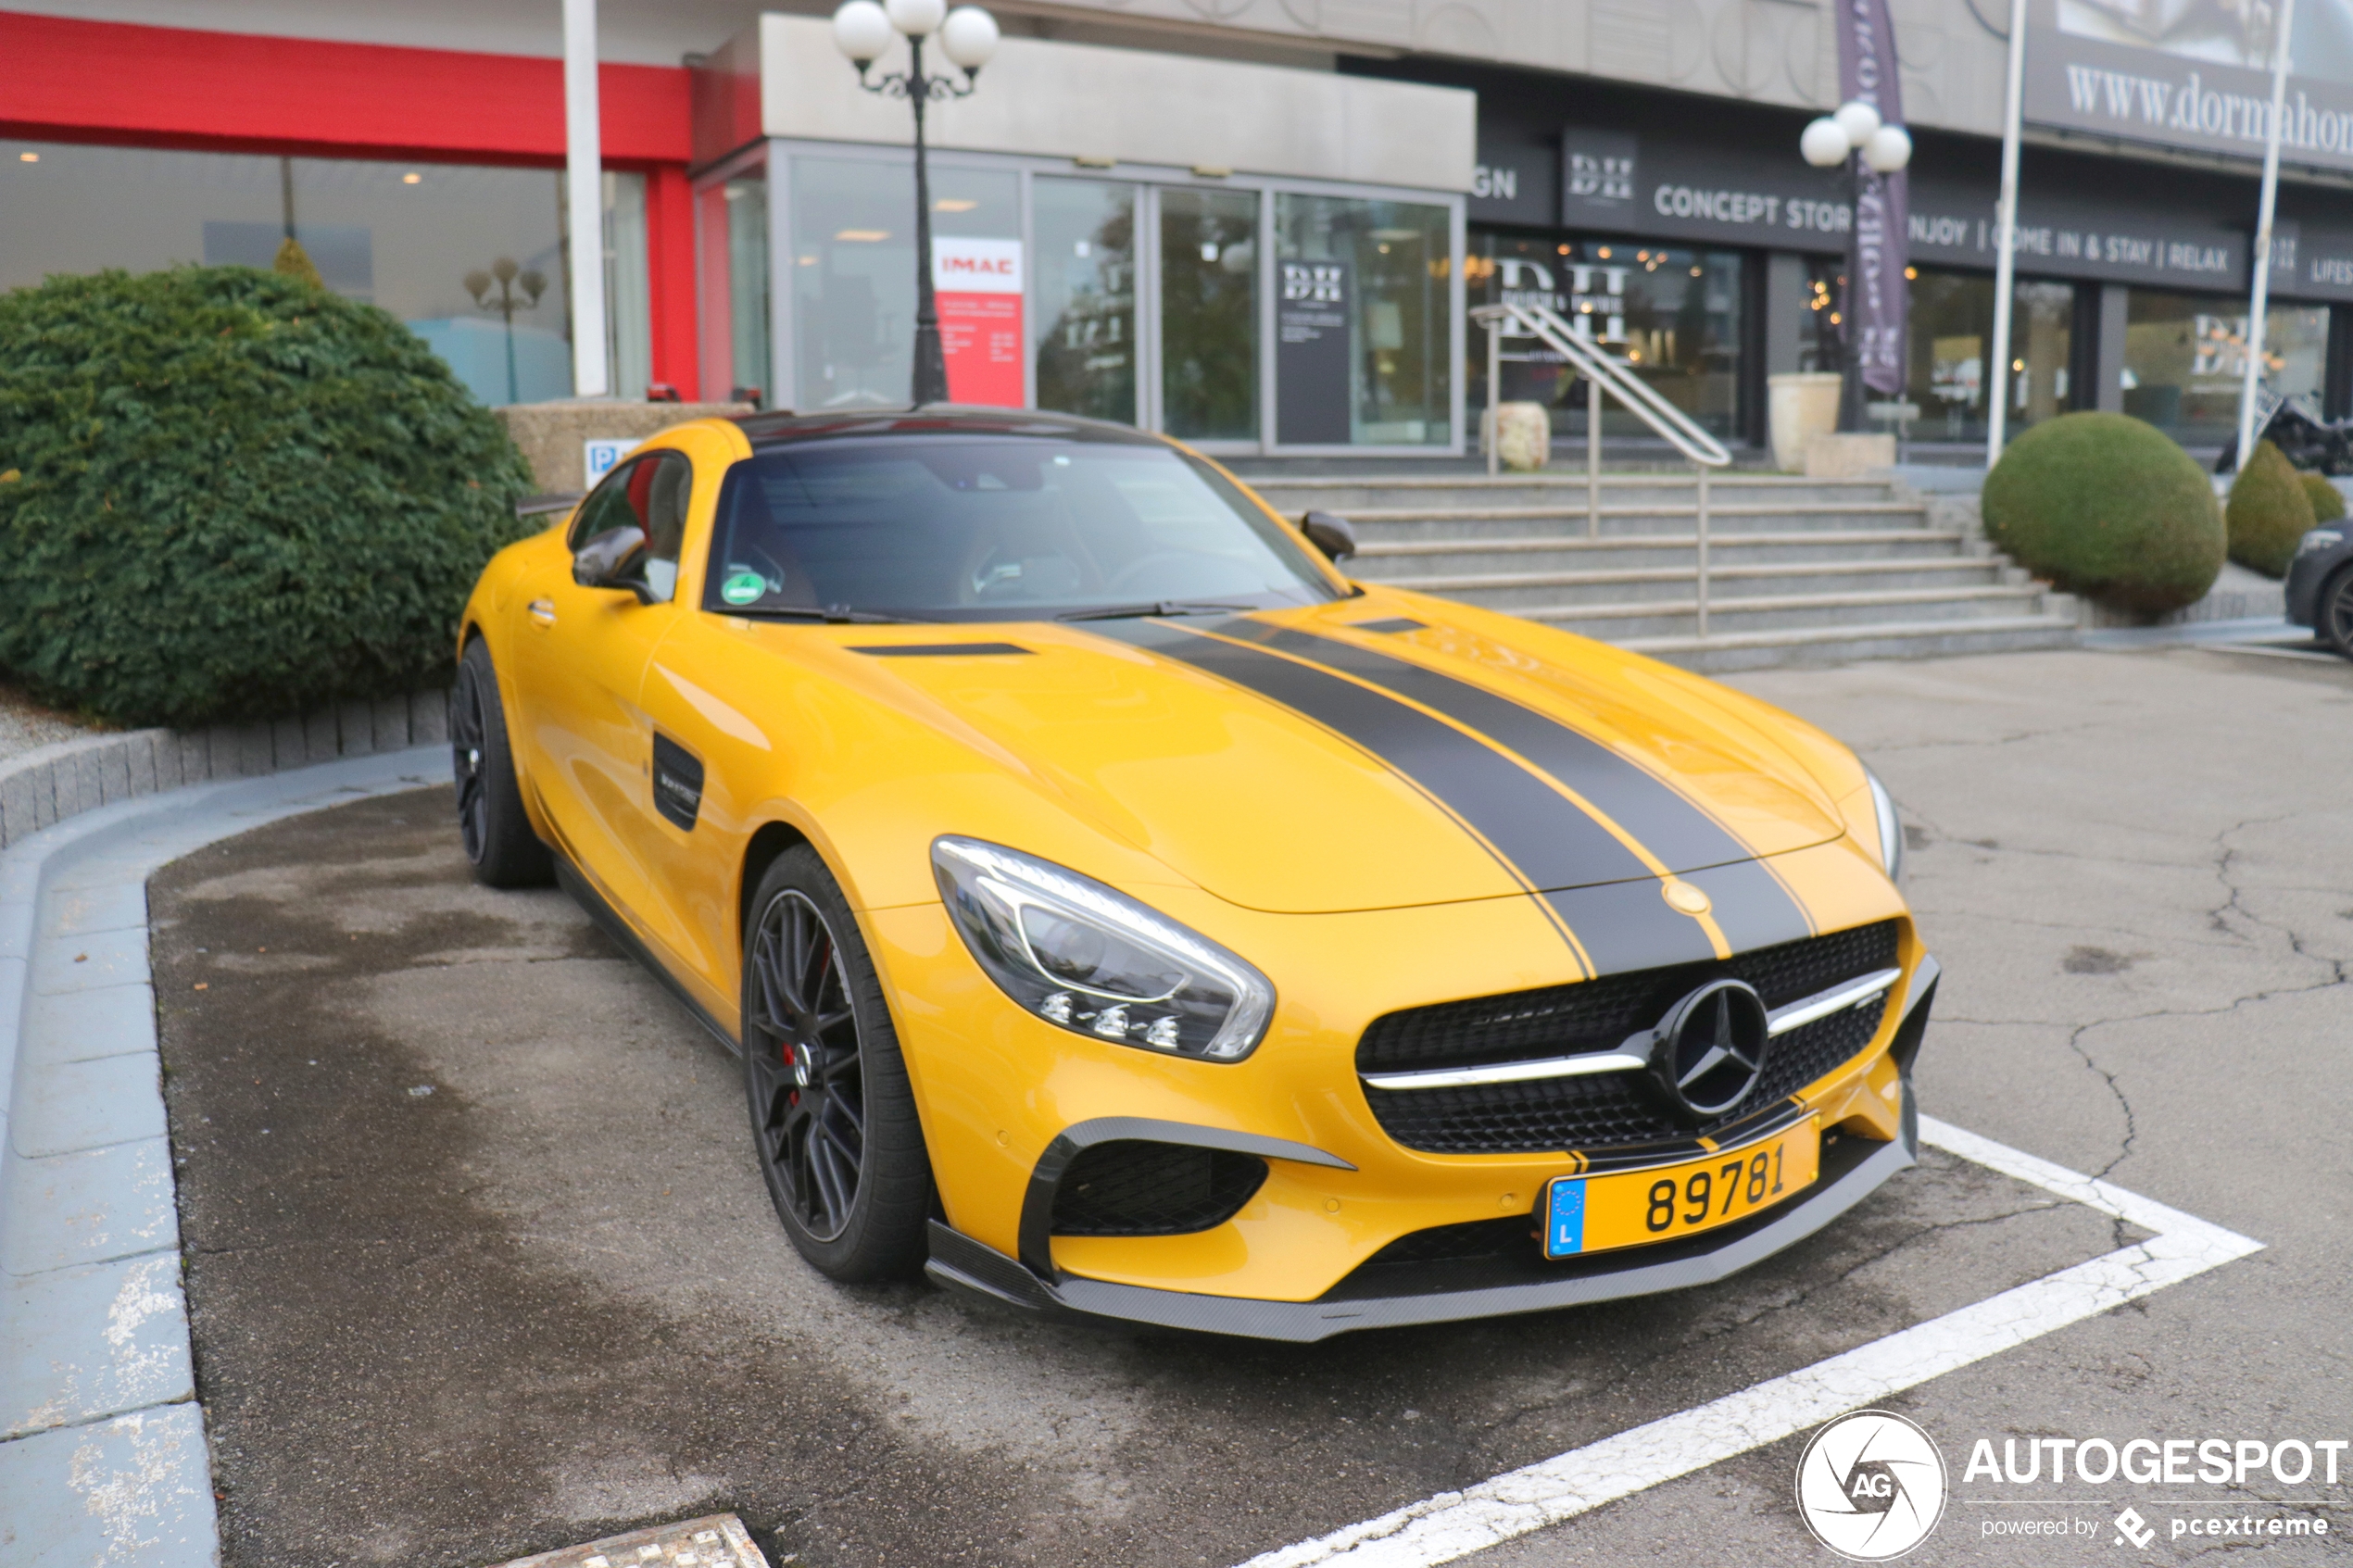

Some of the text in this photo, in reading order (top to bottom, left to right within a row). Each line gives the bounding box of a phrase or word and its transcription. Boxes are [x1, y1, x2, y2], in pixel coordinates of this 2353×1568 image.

[1468, 164, 1516, 201] GN
[1655, 184, 1780, 226] CONCEPT
[1786, 196, 1852, 232] STOR
[1908, 215, 1969, 246] NJOY
[2056, 231, 2080, 257] IN
[2084, 233, 2100, 261] &
[2105, 235, 2152, 266] STAY
[2168, 241, 2228, 273] RELAX
[942, 257, 1013, 276] IMAC
[1645, 1143, 1784, 1233] 89781
[1559, 1223, 1572, 1245] L
